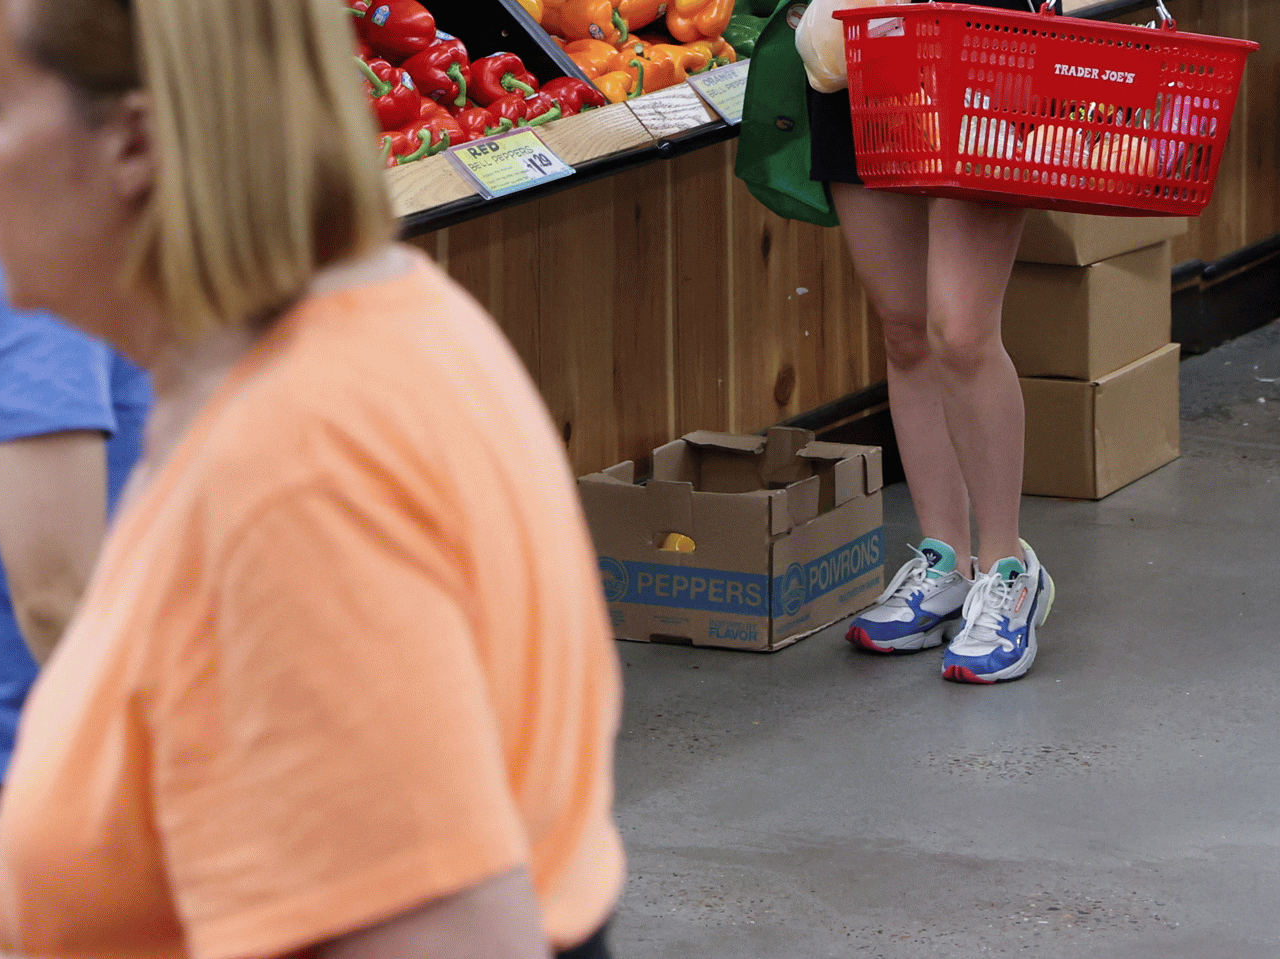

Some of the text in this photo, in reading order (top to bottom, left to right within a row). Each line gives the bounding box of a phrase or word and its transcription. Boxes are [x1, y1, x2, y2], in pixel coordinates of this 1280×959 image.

[1054, 63, 1136, 84] TRADER JOE'S
[467, 141, 500, 159] RED
[468, 145, 534, 172] BELL PEPPERS
[809, 534, 880, 597] POIVRONS
[637, 571, 763, 607] PEPPERS
[708, 626, 758, 642] FLAVOR
